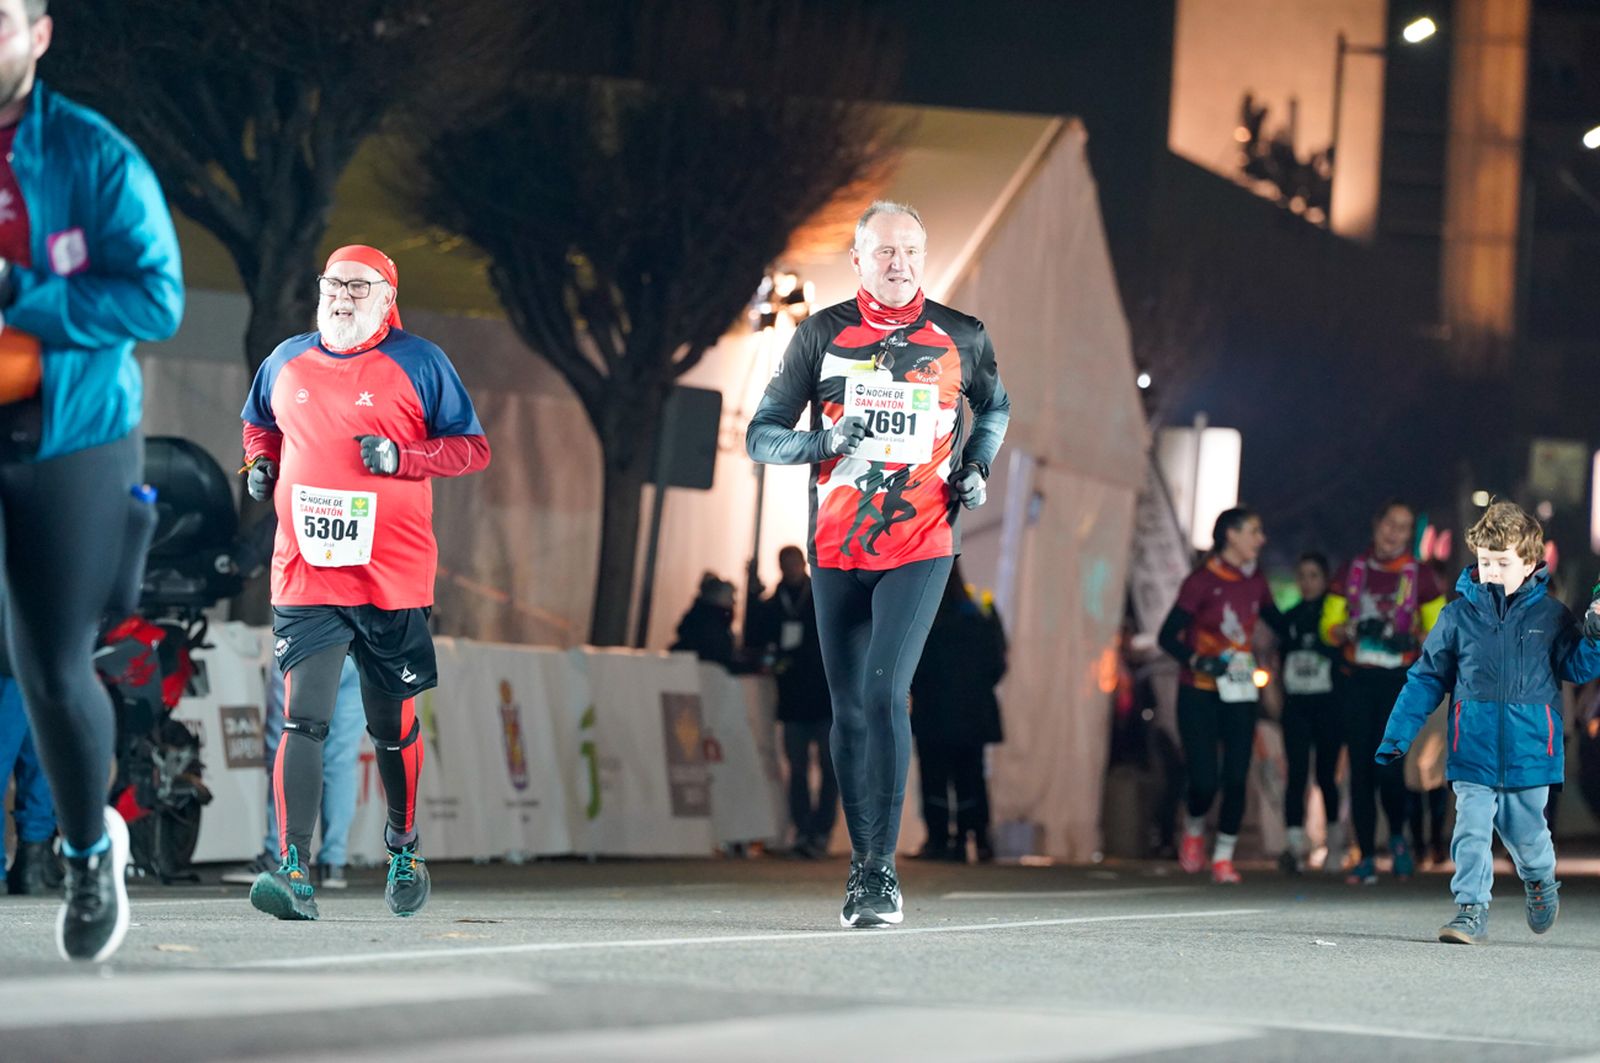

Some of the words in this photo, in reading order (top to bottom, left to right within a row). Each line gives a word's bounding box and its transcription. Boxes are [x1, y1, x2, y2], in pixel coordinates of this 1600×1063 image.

[866, 389, 892, 398] NOCHE
[894, 391, 904, 399] DE
[855, 398, 873, 407] SAN
[865, 410, 917, 436] 7691
[308, 496, 332, 506] NOCHE
[333, 499, 343, 507] DE
[300, 504, 314, 513] SAN
[304, 515, 358, 541] 5304
